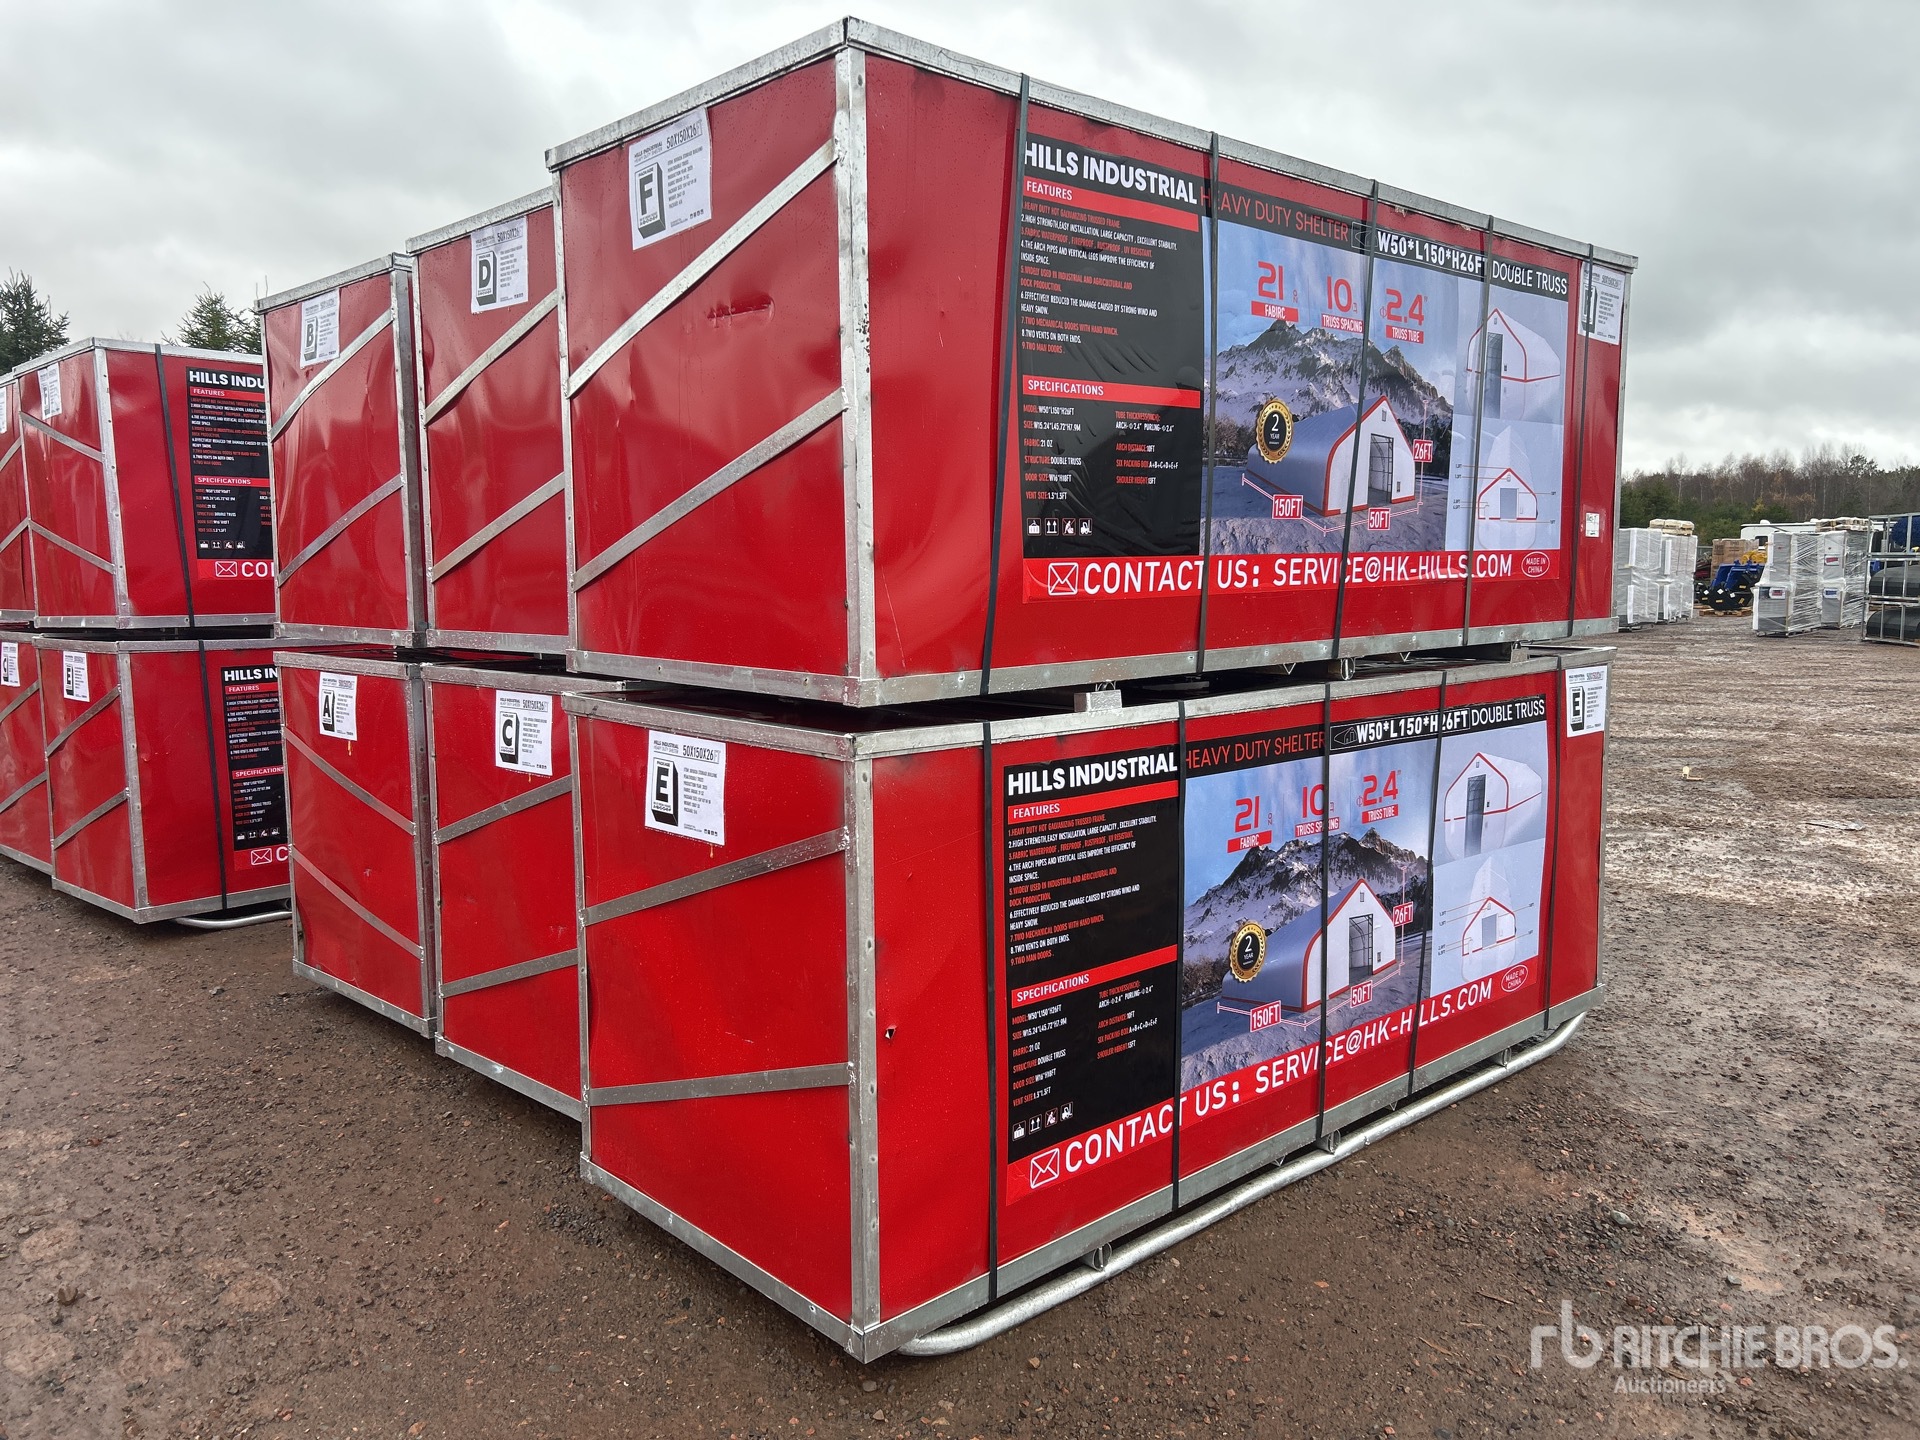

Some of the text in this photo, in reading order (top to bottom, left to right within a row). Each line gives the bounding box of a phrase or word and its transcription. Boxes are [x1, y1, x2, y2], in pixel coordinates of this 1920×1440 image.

[1024, 142, 1197, 204] HILLS INDUSTRIAL
[639, 173, 653, 216] F
[1026, 181, 1072, 200] FEATURES
[1200, 186, 1348, 242] HAVY DUTY SHELTER
[479, 259, 491, 288] D
[1258, 261, 1284, 300] 21
[1493, 260, 1533, 287] DOUBLE
[1536, 271, 1567, 295] TRUSS
[1327, 276, 1352, 312] 10
[1265, 304, 1285, 320] FABIRC
[1323, 314, 1362, 332] TRUSS SPACING
[306, 324, 314, 347] B
[1392, 327, 1420, 342] TRUSS TUBE
[189, 371, 228, 385] HILLS
[1028, 380, 1104, 396] SPECIFICATIONS
[1272, 414, 1279, 431] 2
[1414, 442, 1432, 460] 26FT
[198, 477, 251, 485] SPECIFICATIONS
[1274, 498, 1302, 517] 150FT
[1369, 511, 1390, 528] 50FT
[1084, 561, 1204, 594] CONTACT
[1218, 560, 1259, 589] US:
[224, 668, 262, 682] HILLS
[323, 695, 330, 717] A
[1472, 706, 1512, 727] DOUBLE
[1516, 699, 1544, 718] TRUSS
[1573, 692, 1580, 716] E
[502, 719, 513, 746] C
[1235, 739, 1271, 762] DUTY
[1274, 732, 1325, 756] SHELTER
[656, 766, 669, 802] E
[1008, 752, 1178, 796] HILLS INDUSTRIAL
[1013, 803, 1060, 819] FEATURES
[1235, 796, 1260, 832] 21
[1368, 806, 1394, 822] TRUSS TUBE
[1296, 822, 1314, 836] TRUSS
[1240, 834, 1259, 849] FABIRC
[1394, 905, 1412, 925] 26FT
[1245, 935, 1252, 953] 2
[1506, 969, 1525, 984] MADE IN
[1508, 978, 1521, 990] CHINA
[1016, 974, 1090, 1002] SPECIFICATIONS
[1352, 984, 1371, 1005] 50FT
[1253, 1005, 1279, 1029] 150FT
[1065, 1097, 1187, 1173] CONTACT
[1196, 1081, 1240, 1116] US:
